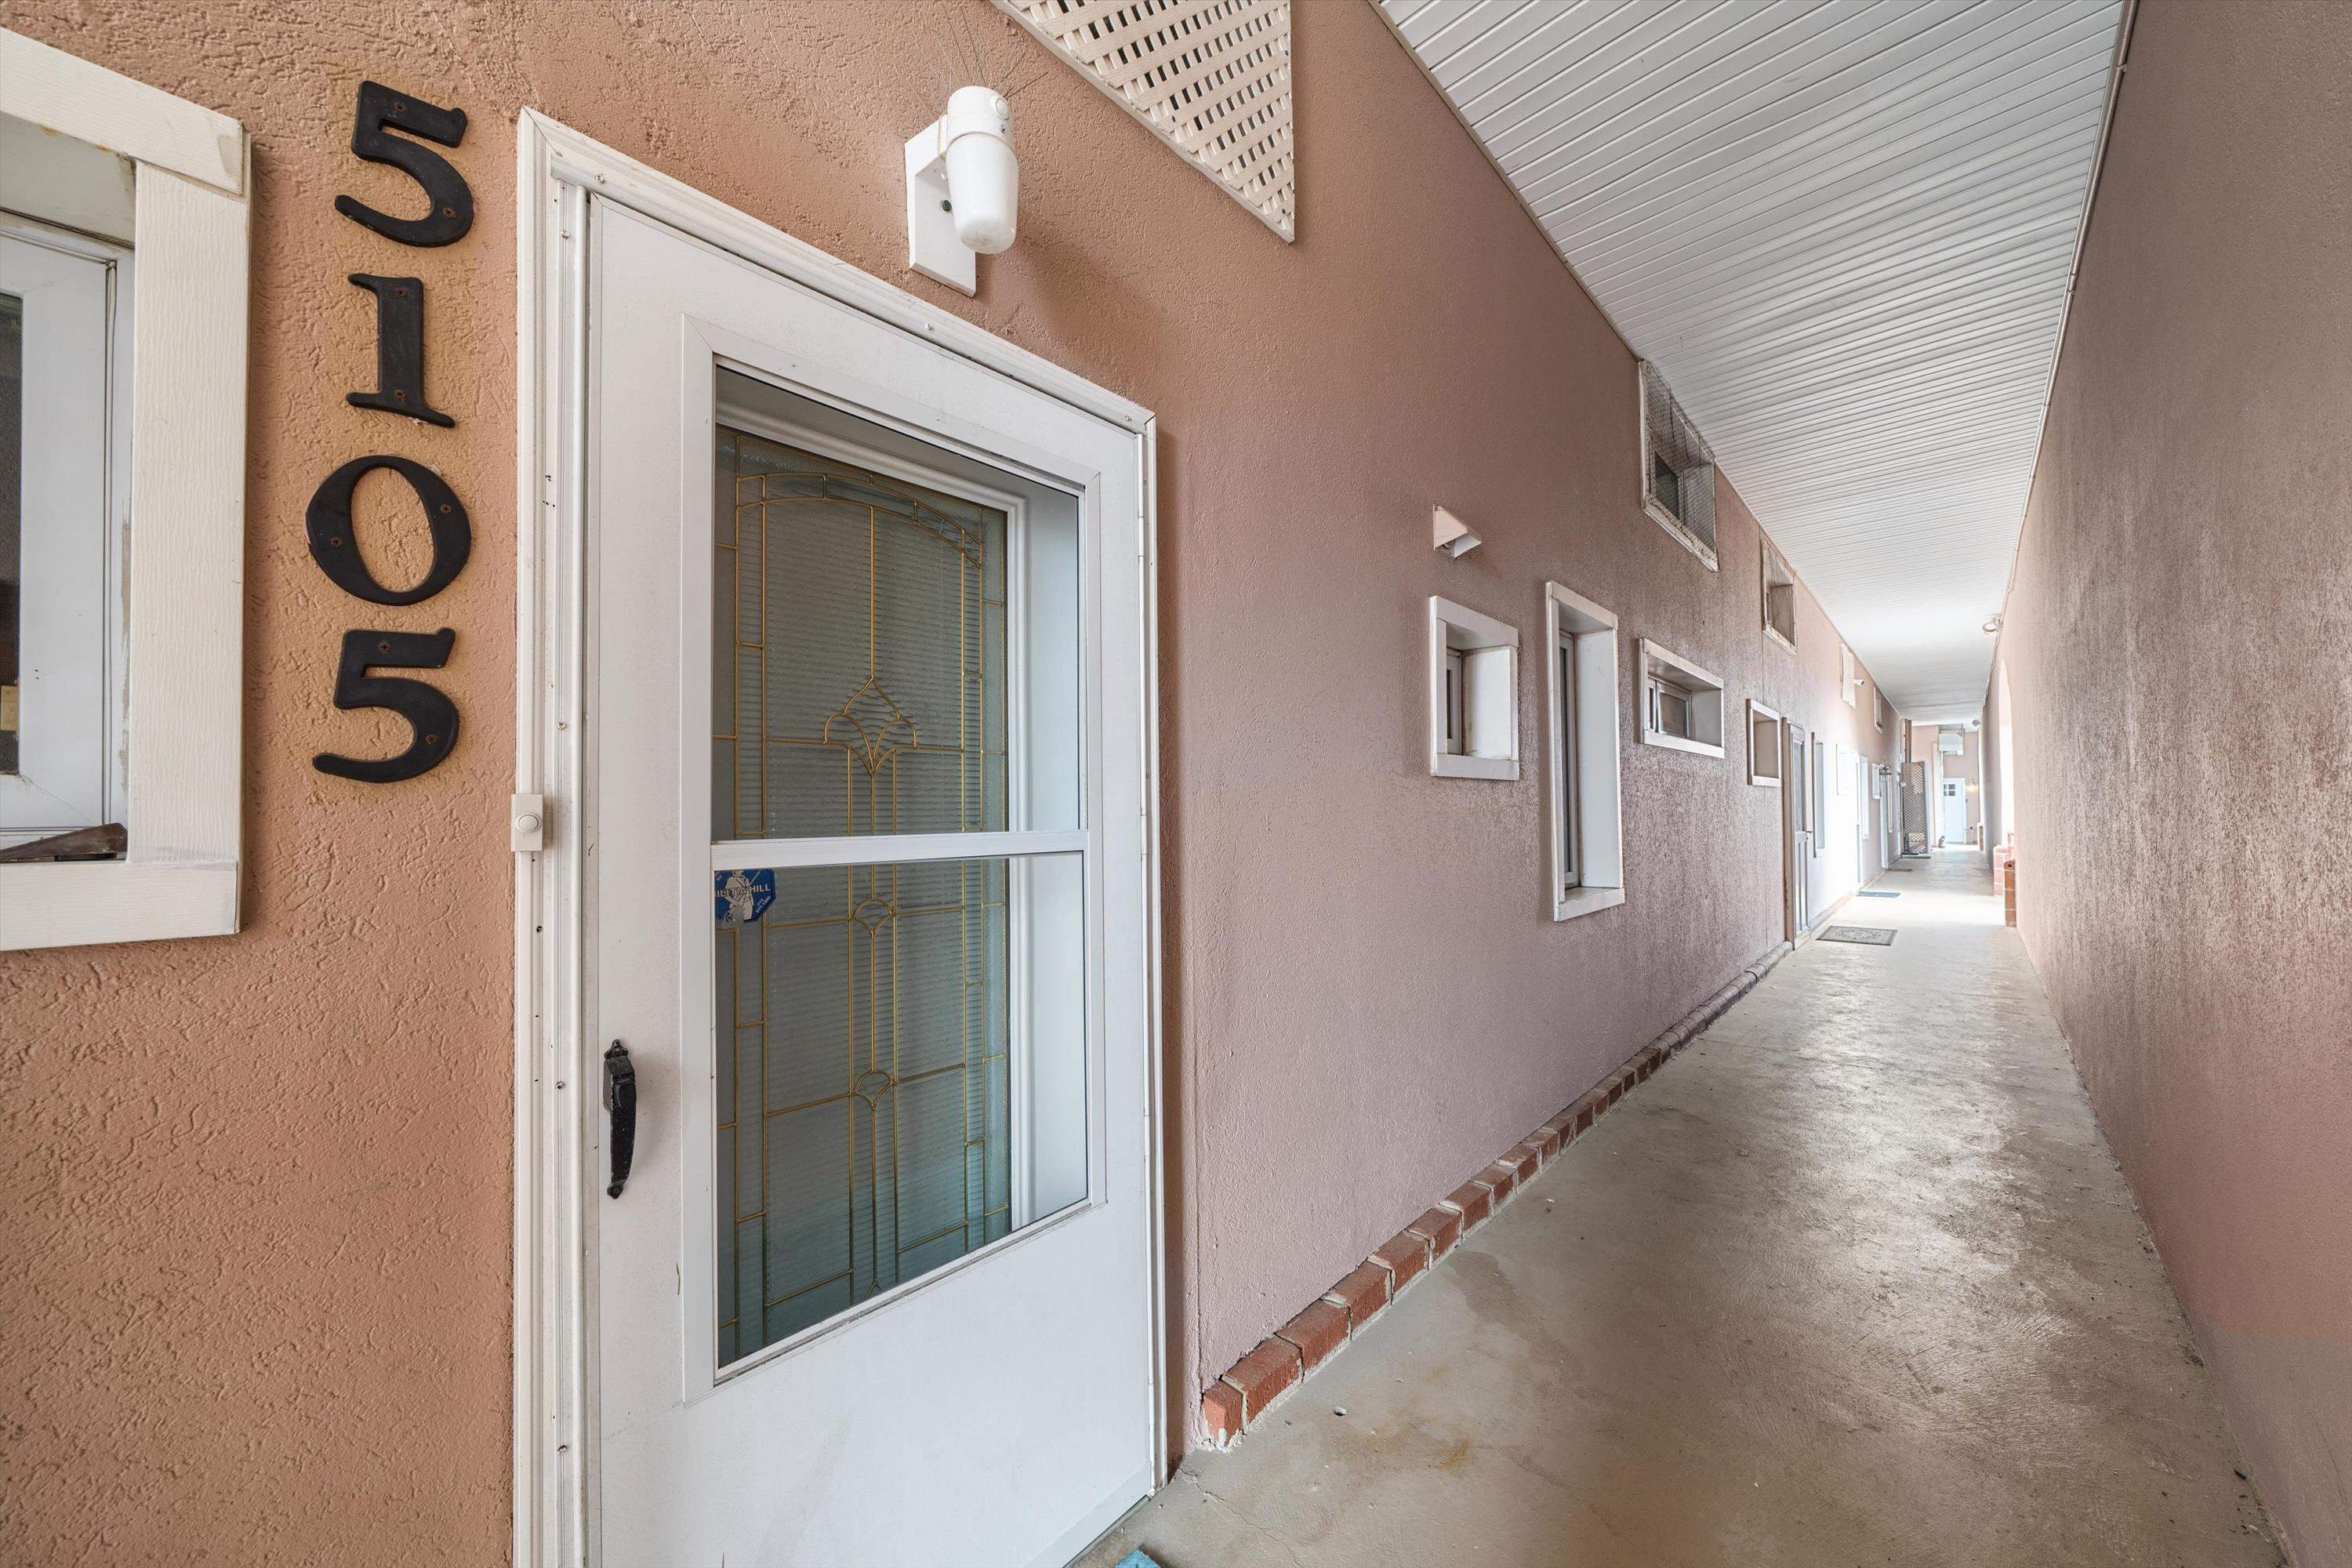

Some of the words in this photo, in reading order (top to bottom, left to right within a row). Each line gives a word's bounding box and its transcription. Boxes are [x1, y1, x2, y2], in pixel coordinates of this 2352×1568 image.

[305, 81, 474, 783] 5105
[714, 887, 747, 898] ILITIA
[749, 884, 771, 893] HILL
